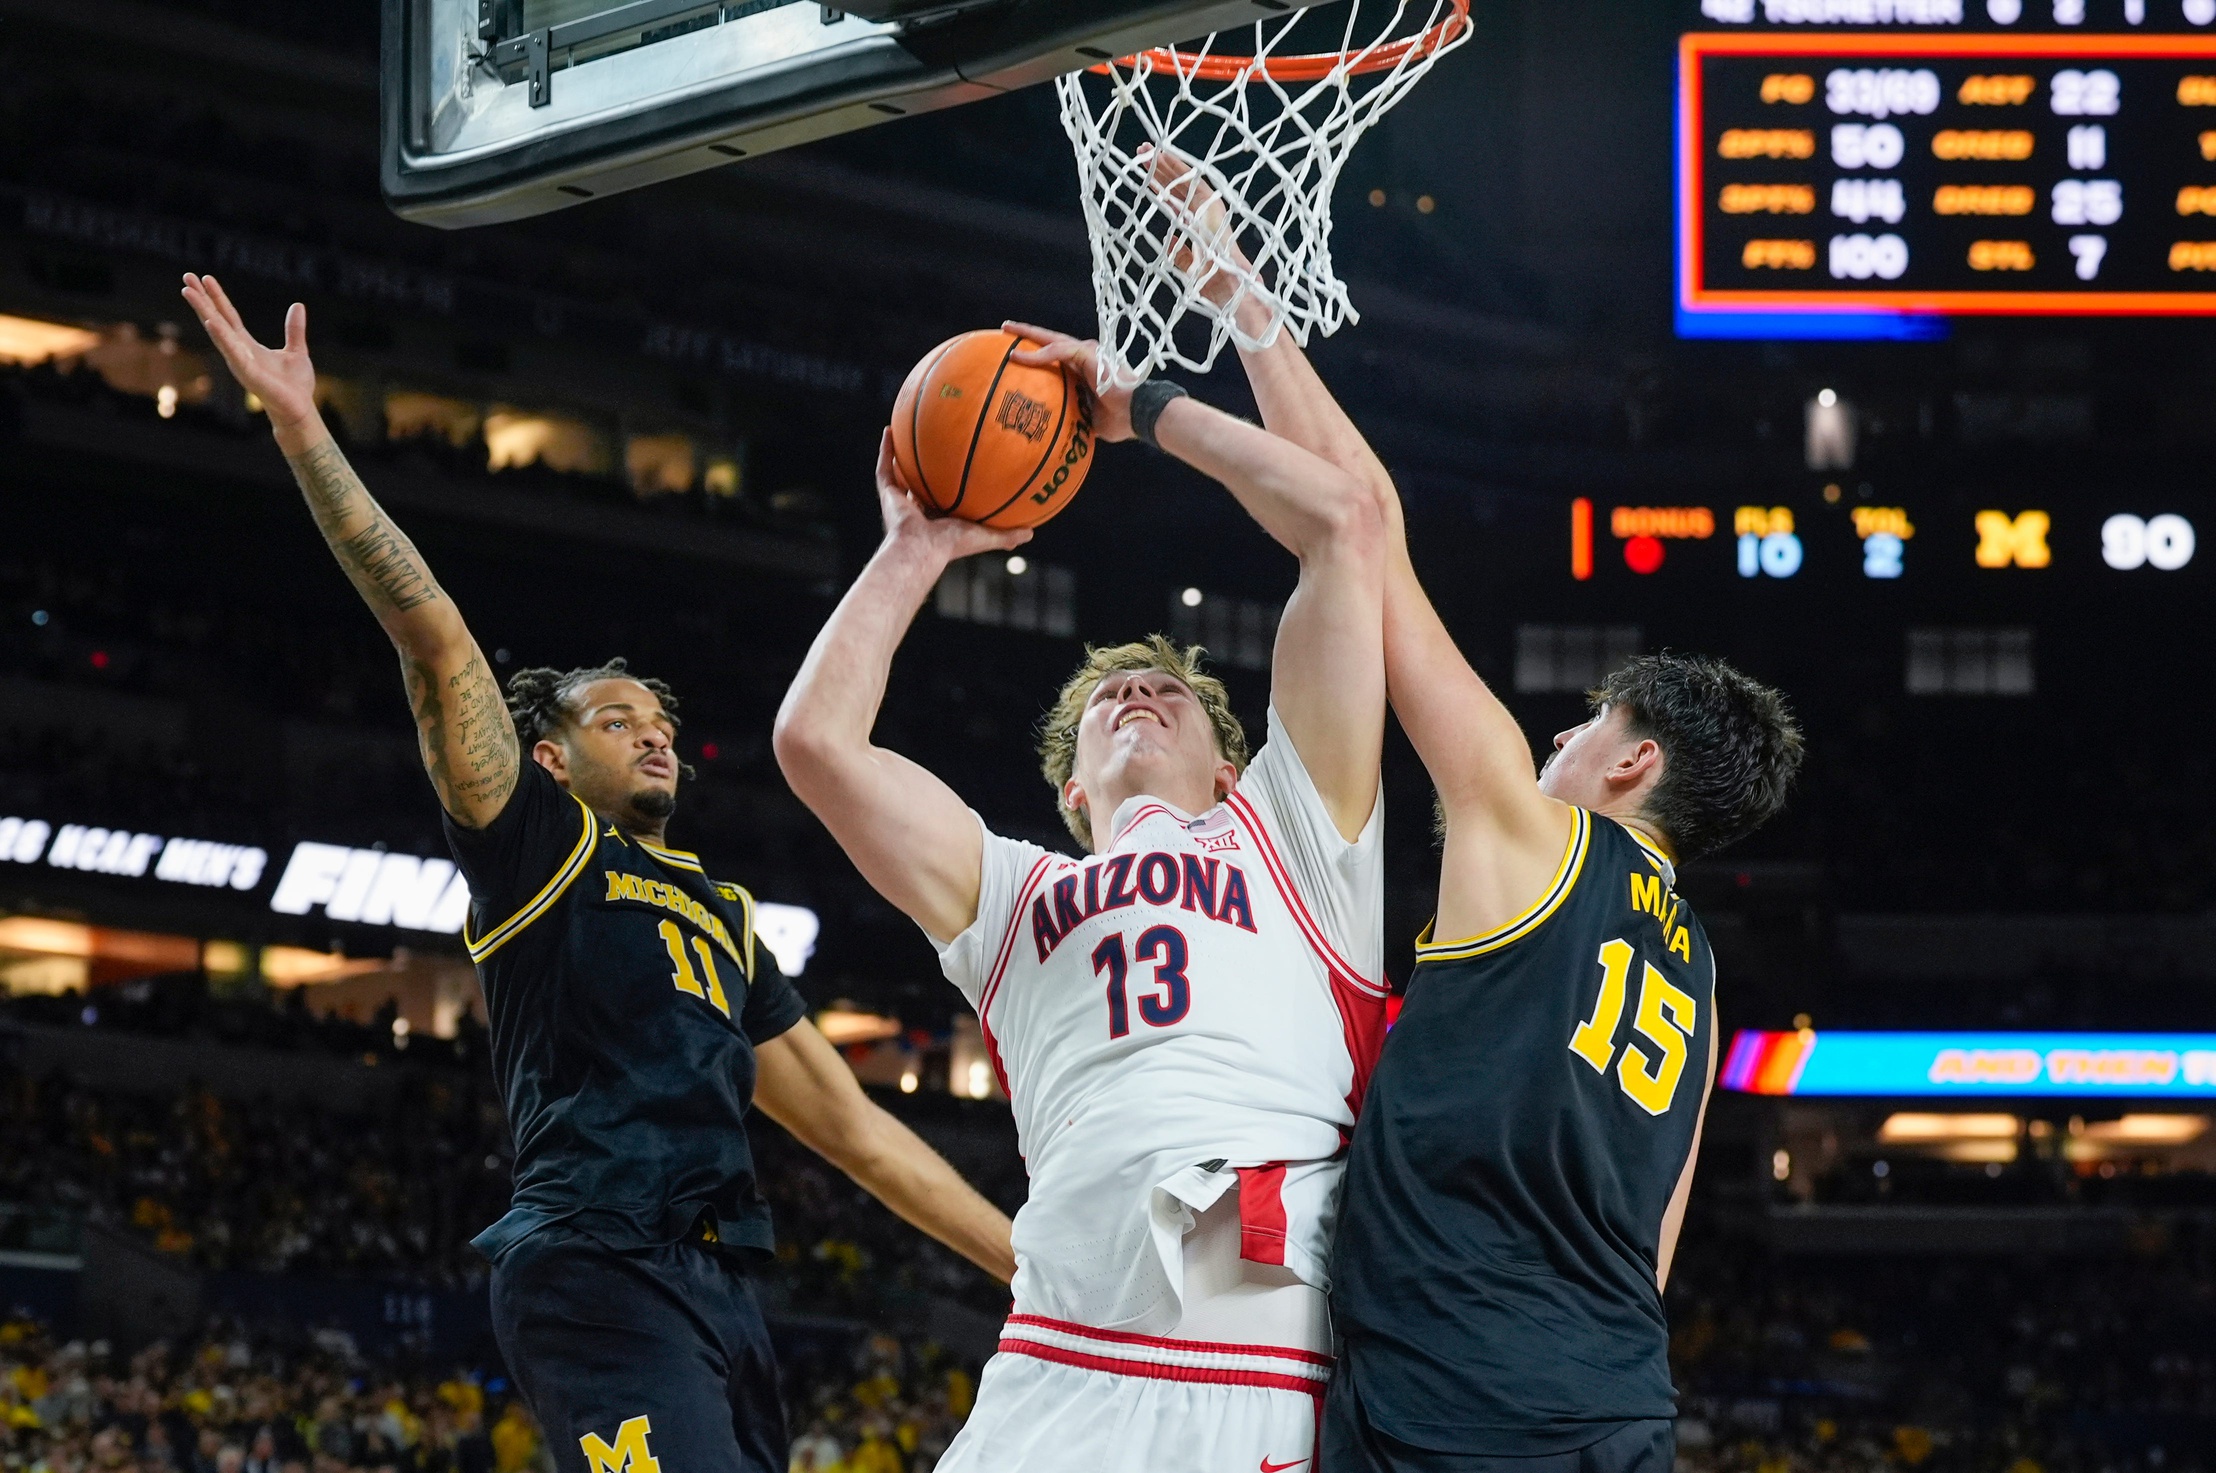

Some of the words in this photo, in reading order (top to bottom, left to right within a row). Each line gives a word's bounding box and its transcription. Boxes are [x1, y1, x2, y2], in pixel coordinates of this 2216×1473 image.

[2050, 68, 2121, 116] 22
[1831, 123, 1905, 170] 50
[2067, 124, 2106, 170] 11
[1831, 178, 1906, 224] 44
[2051, 179, 2123, 225] 25
[1828, 233, 1909, 280] 100
[2068, 234, 2107, 281] 7
[1737, 532, 1803, 578] 10
[1862, 532, 1904, 578] 2
[2101, 512, 2197, 571] 90
[1032, 852, 1258, 965] ARIZONA
[657, 918, 731, 1020] 11
[1091, 924, 1191, 1040] 13
[1568, 938, 1696, 1117] 15
[1928, 1048, 2043, 1085] AND
[2047, 1049, 2179, 1085] THEN
[579, 1414, 662, 1473] M
